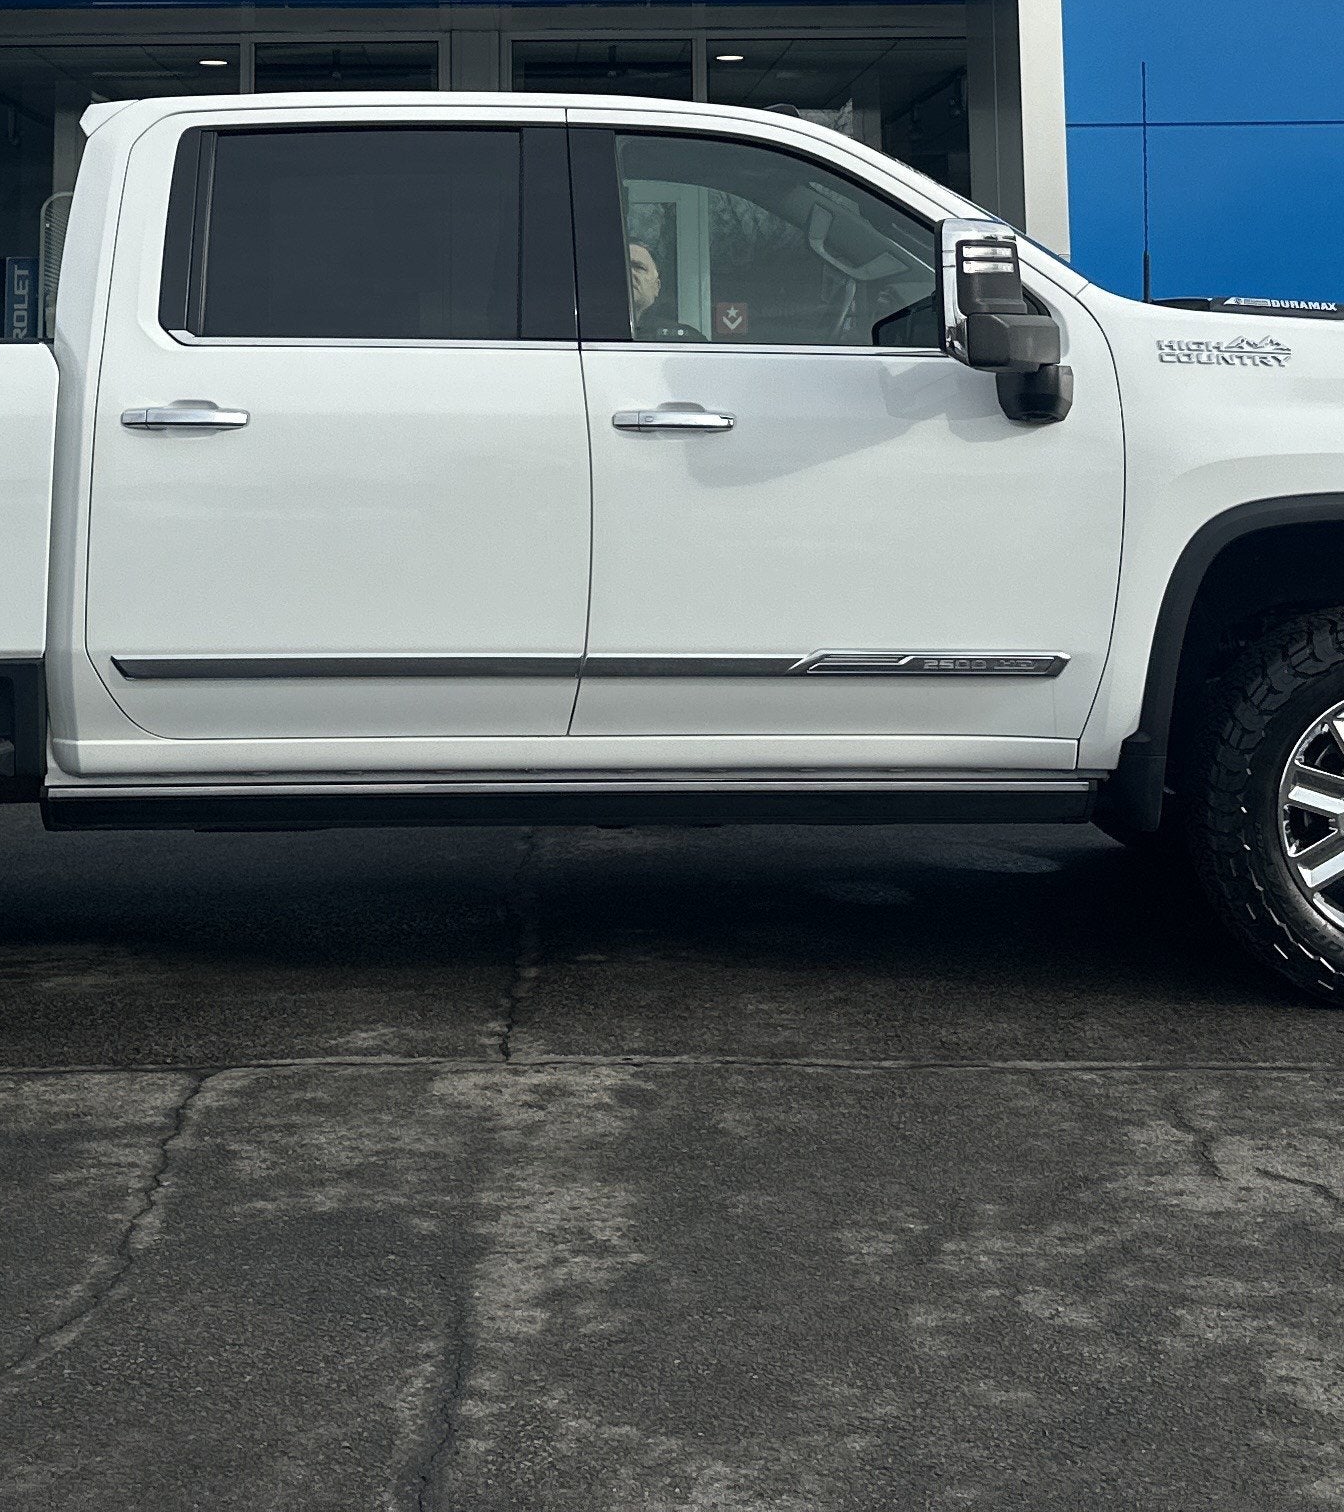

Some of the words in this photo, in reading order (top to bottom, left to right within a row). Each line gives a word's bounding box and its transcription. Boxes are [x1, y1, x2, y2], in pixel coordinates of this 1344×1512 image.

[1270, 299, 1338, 311] DURAMAX
[1155, 339, 1222, 352] HIGH
[1158, 352, 1292, 367] COUNTRY
[923, 659, 987, 670] 2500
